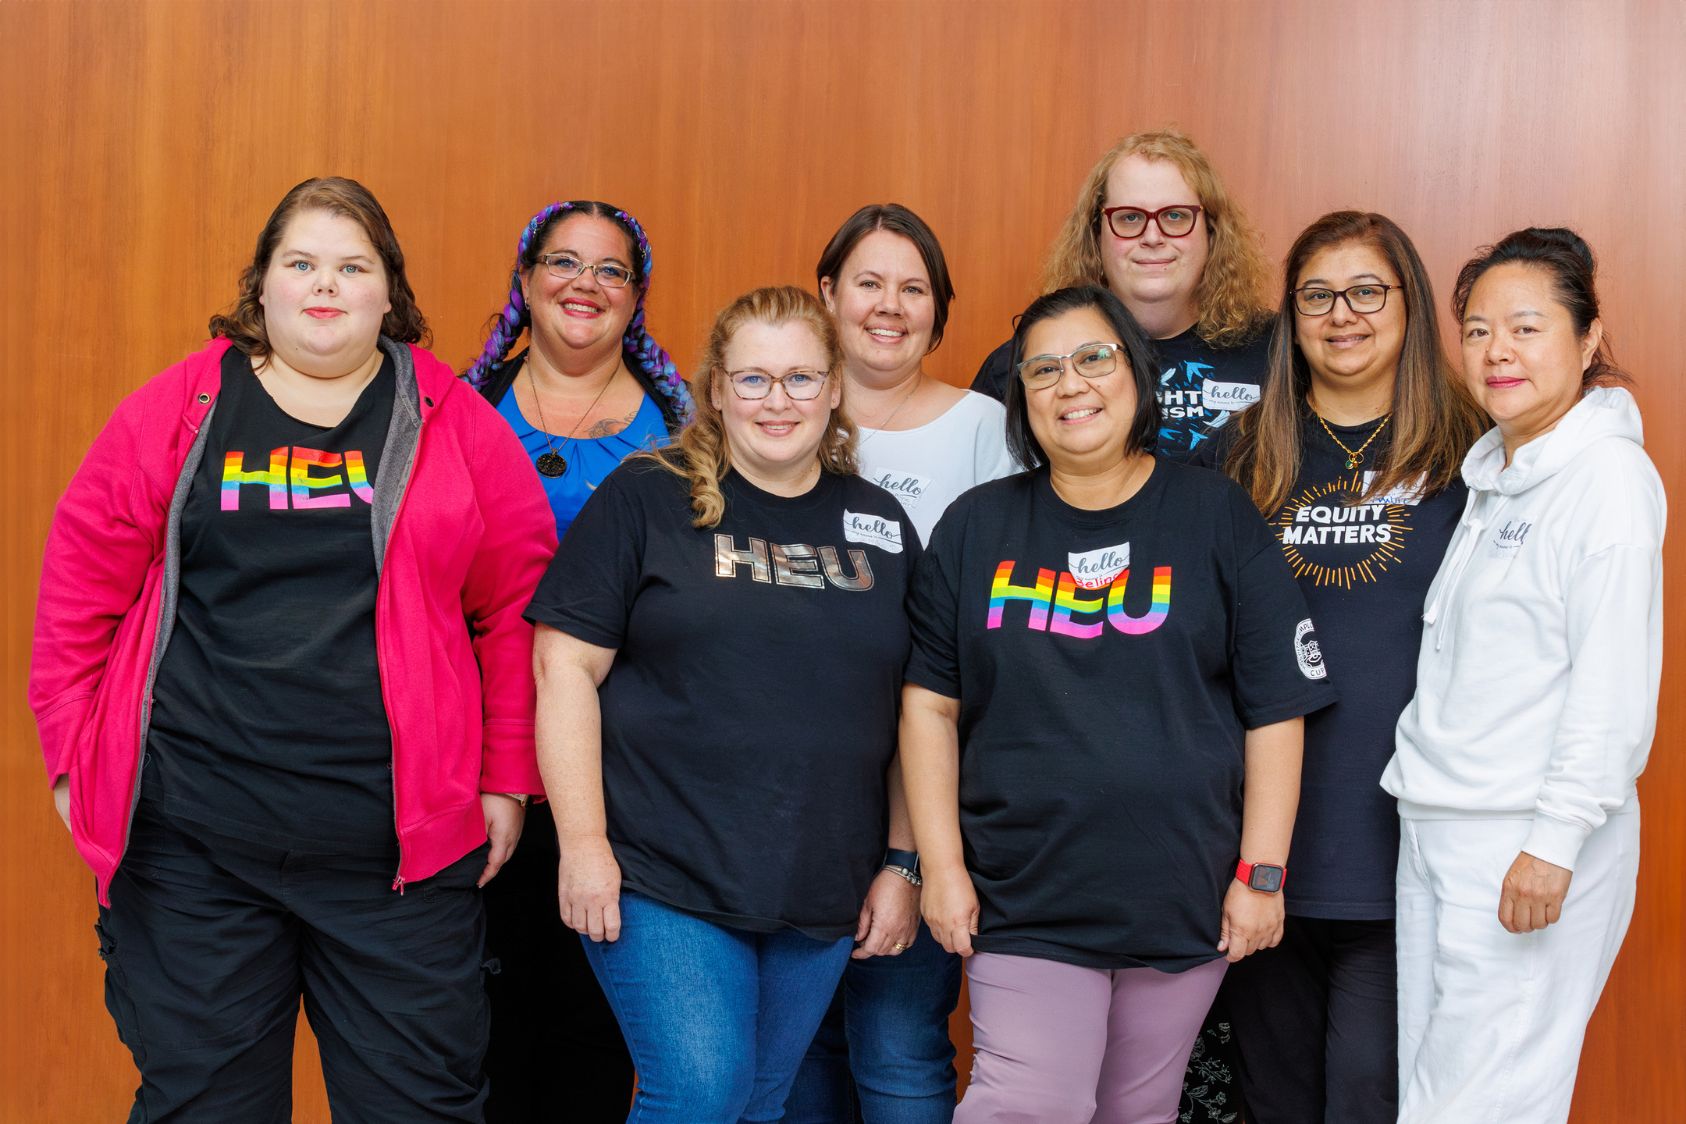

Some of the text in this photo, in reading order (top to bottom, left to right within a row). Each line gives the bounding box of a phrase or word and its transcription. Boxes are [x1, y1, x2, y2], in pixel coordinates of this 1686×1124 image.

[1208, 385, 1256, 401] hello
[873, 473, 922, 496] hello
[1295, 504, 1385, 524] EQUITY
[848, 516, 897, 540] hello
[1282, 523, 1392, 545] MATTERS
[1498, 520, 1533, 545] hell
[714, 533, 875, 592] HEU
[1074, 550, 1127, 574] hello
[987, 560, 1172, 639] HEU
